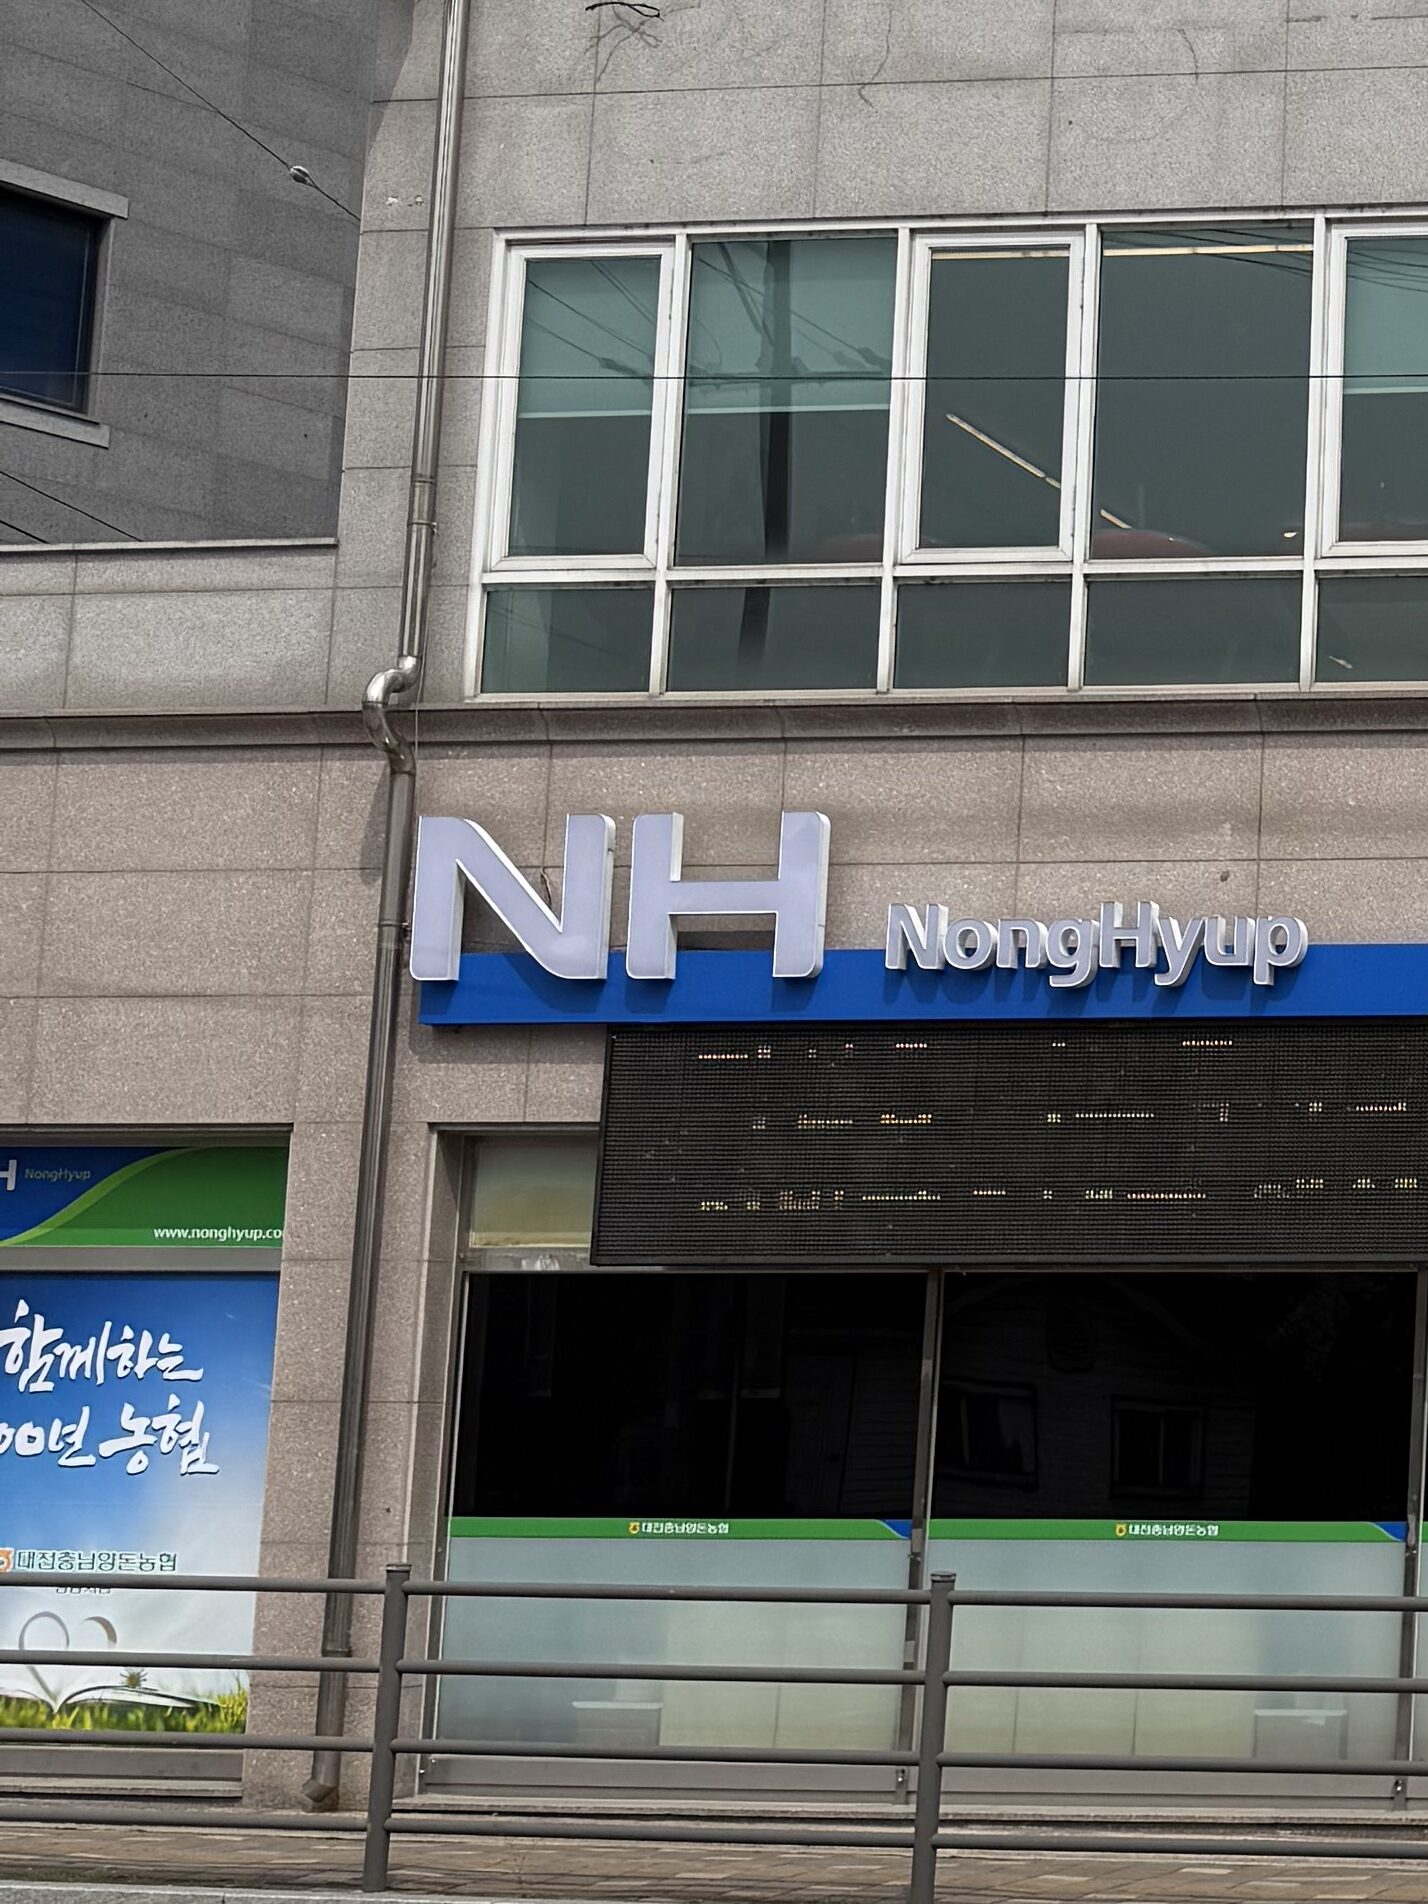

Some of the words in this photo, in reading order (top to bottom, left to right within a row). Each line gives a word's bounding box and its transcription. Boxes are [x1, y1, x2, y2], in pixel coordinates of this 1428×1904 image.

[409, 812, 830, 981] NH
[885, 901, 1309, 989] NongHyup
[24, 1168, 91, 1182] NongHyup
[99, 1394, 220, 1475] 농협
